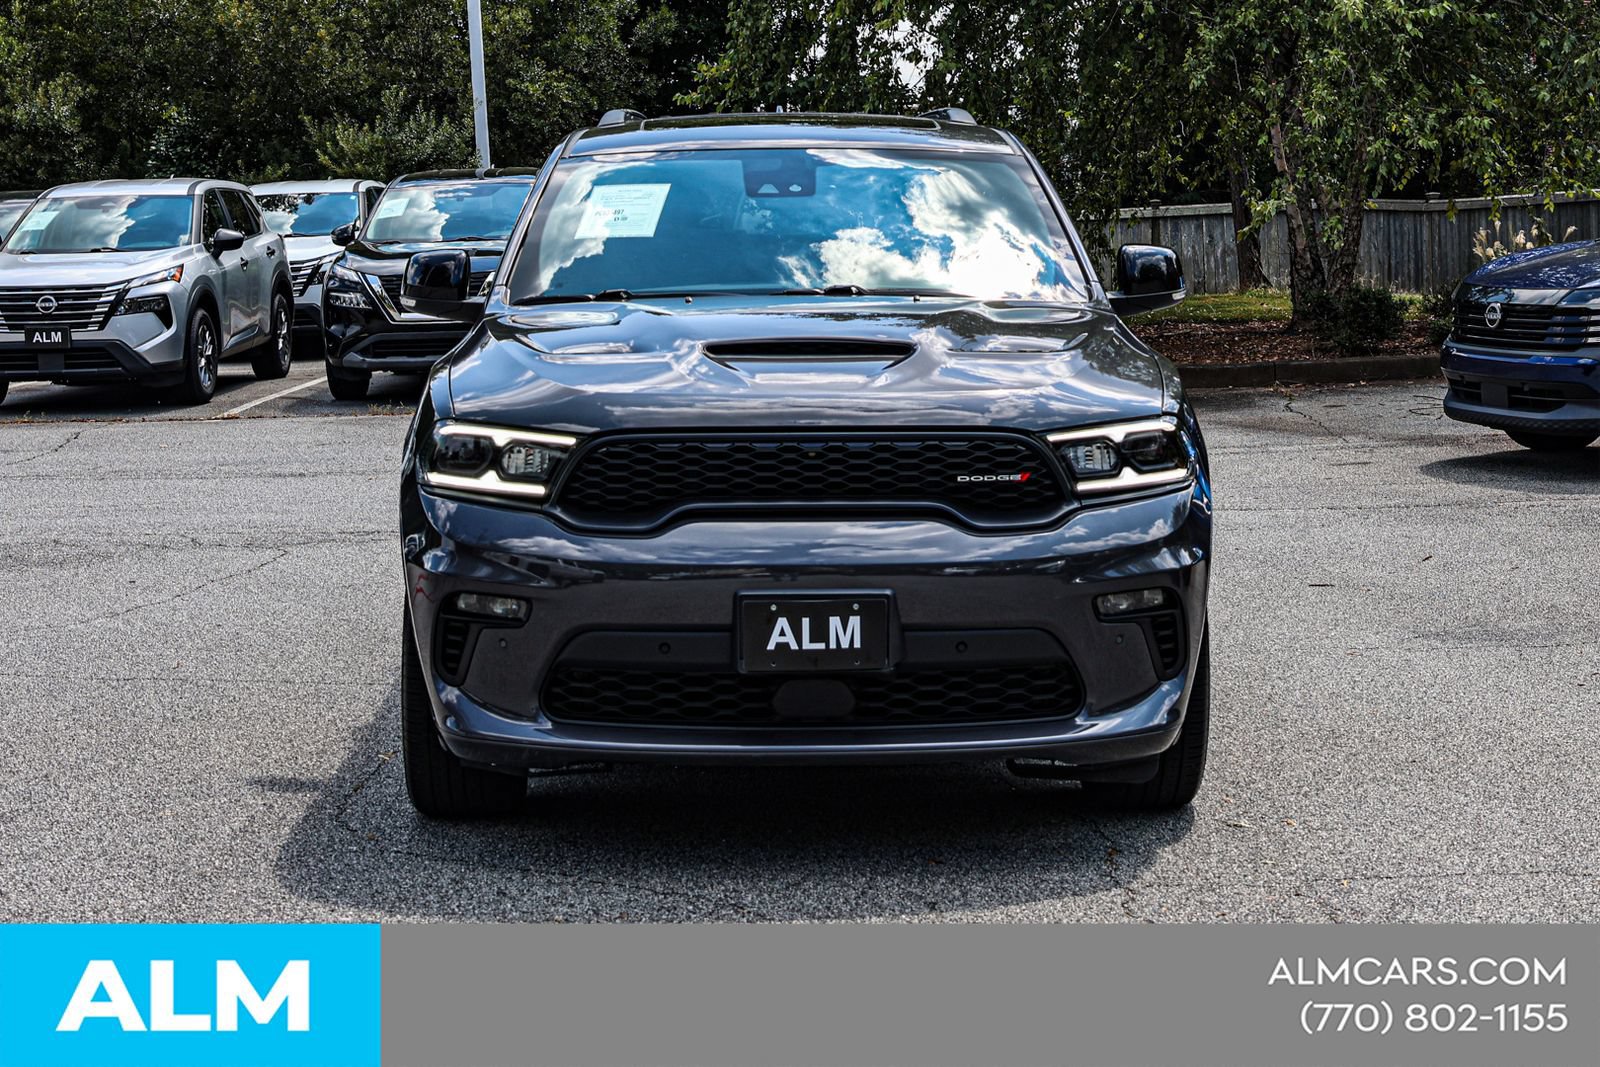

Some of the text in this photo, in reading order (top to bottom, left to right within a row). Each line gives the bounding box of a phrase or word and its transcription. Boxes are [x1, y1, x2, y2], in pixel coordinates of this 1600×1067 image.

[32, 331, 62, 343] ALM
[957, 474, 1022, 482] DODGE
[766, 615, 861, 650] ALM
